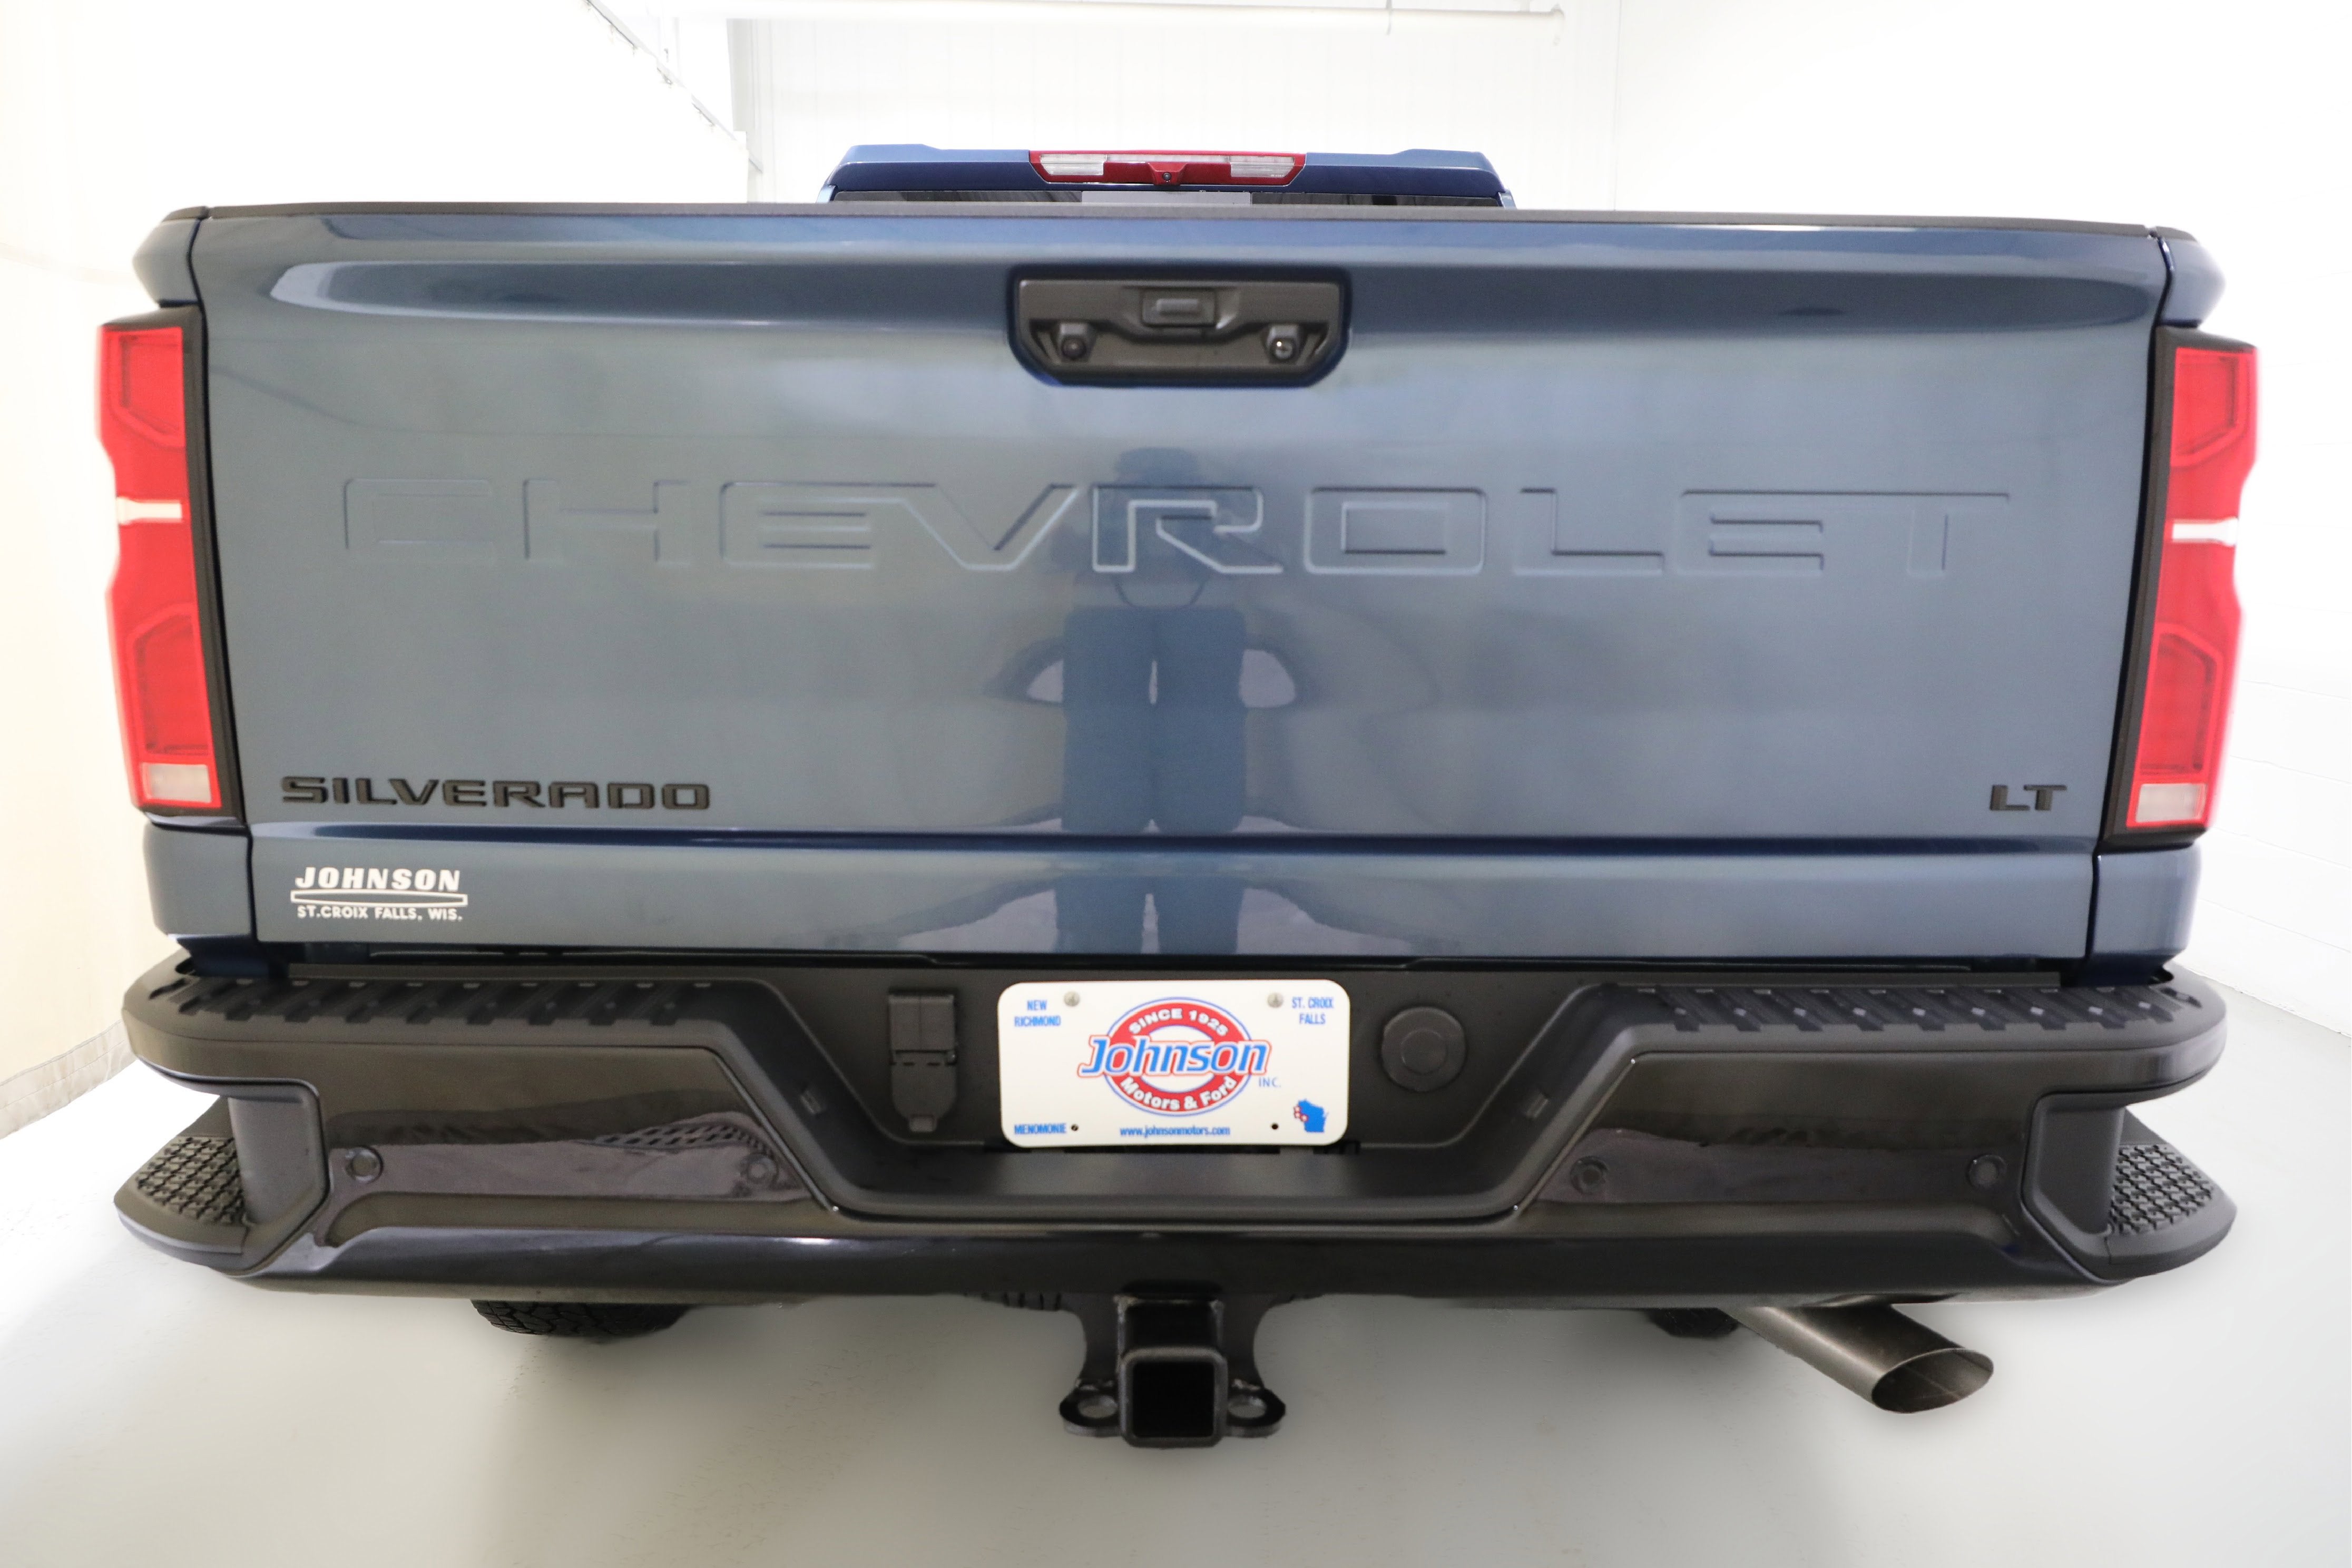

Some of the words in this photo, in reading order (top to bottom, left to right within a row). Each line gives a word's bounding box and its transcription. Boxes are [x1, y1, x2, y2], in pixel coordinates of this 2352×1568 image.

[345, 477, 2010, 577] CHEVROLET
[281, 776, 710, 810] SILVERADO
[1990, 784, 2067, 811] LT
[295, 867, 460, 891] JOHNSON
[374, 906, 423, 920] FALLS,
[428, 908, 463, 920] WIS.
[1027, 1000, 1047, 1011] NEW
[1292, 997, 1306, 1008] ST.
[1308, 997, 1334, 1008] CROIX
[1014, 1016, 1061, 1027] RICHMOND
[1129, 1008, 1182, 1034] SINCE
[1189, 1010, 1229, 1036] 1925
[1299, 1013, 1326, 1024] FALLS
[1081, 1038, 1267, 1073] Johnson
[1258, 1077, 1281, 1087] INC.
[1120, 1076, 1180, 1111] Motors
[1183, 1095, 1198, 1110] &
[1199, 1075, 1237, 1106] Ford
[1014, 1123, 1067, 1135] MENOMONIE
[1120, 1125, 1230, 1139] www.johnsonmotors.com
